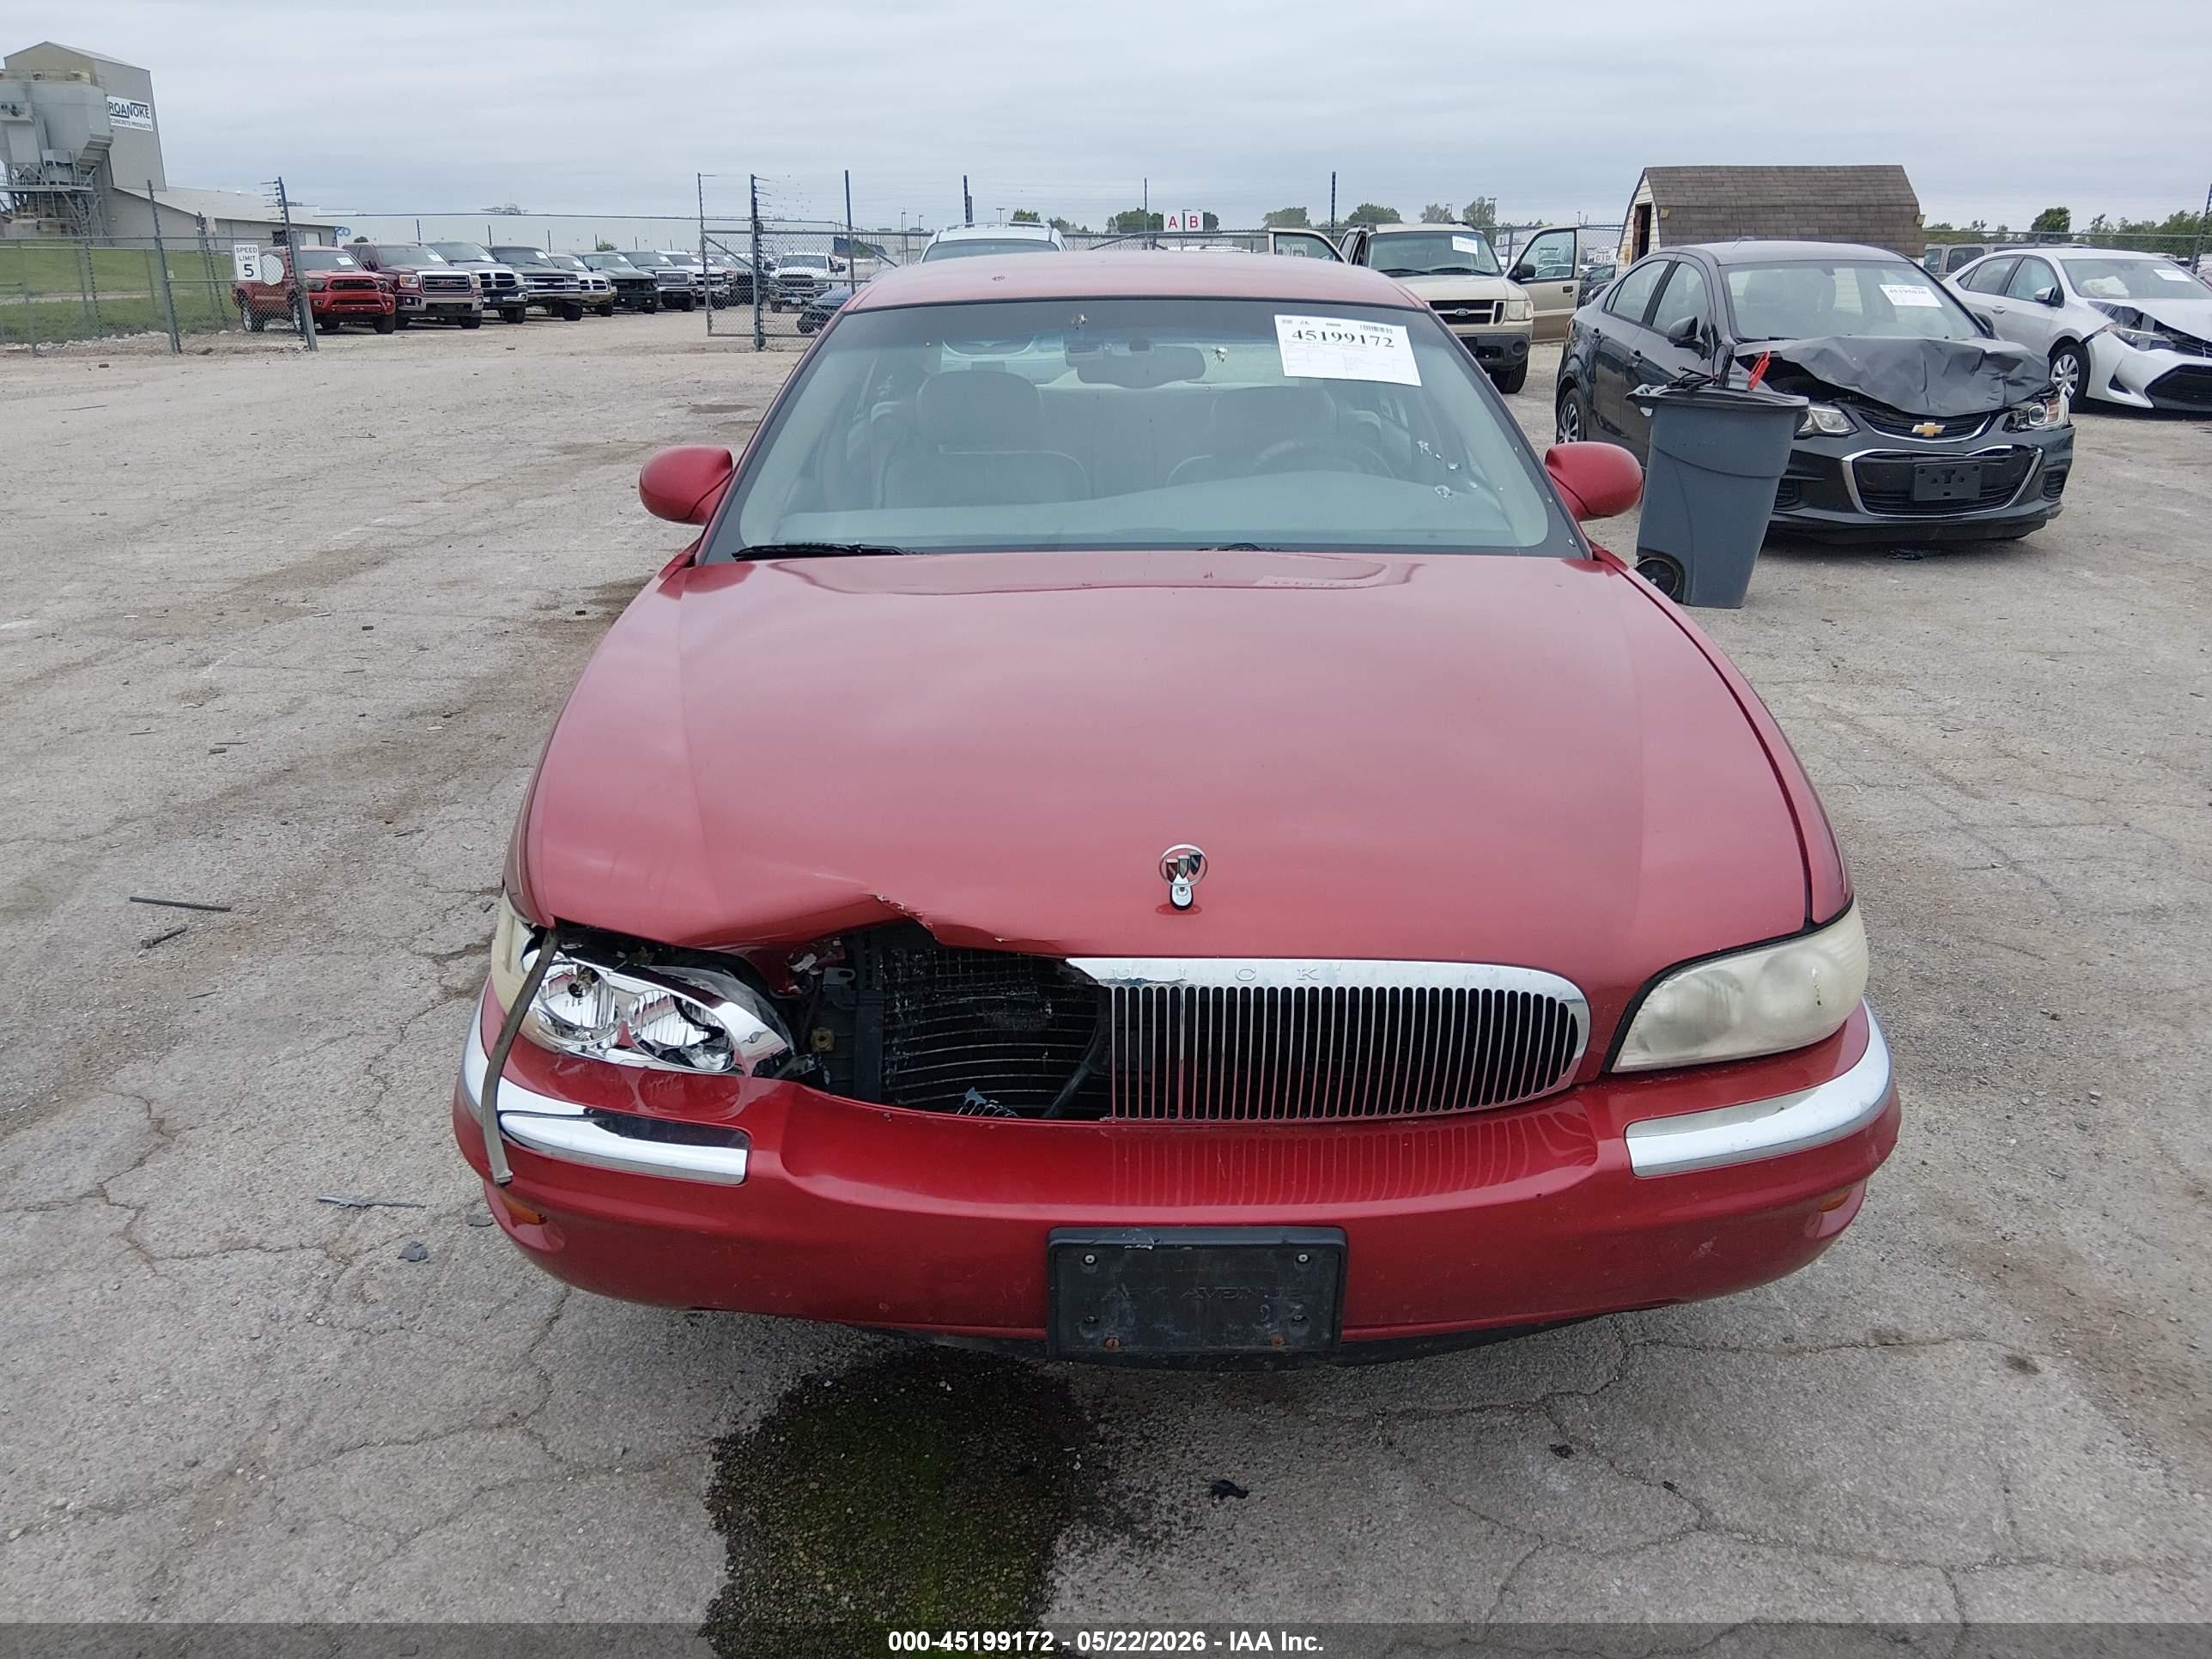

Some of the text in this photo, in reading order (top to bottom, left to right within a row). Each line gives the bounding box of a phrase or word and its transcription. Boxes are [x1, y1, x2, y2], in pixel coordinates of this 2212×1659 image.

[108, 101, 150, 119] ROANOKE
[1168, 216, 1178, 228] A
[1189, 216, 1199, 228] B
[243, 264, 254, 277] 5
[1291, 329, 1395, 349] 45199172
[1112, 968, 1320, 982] UICK
